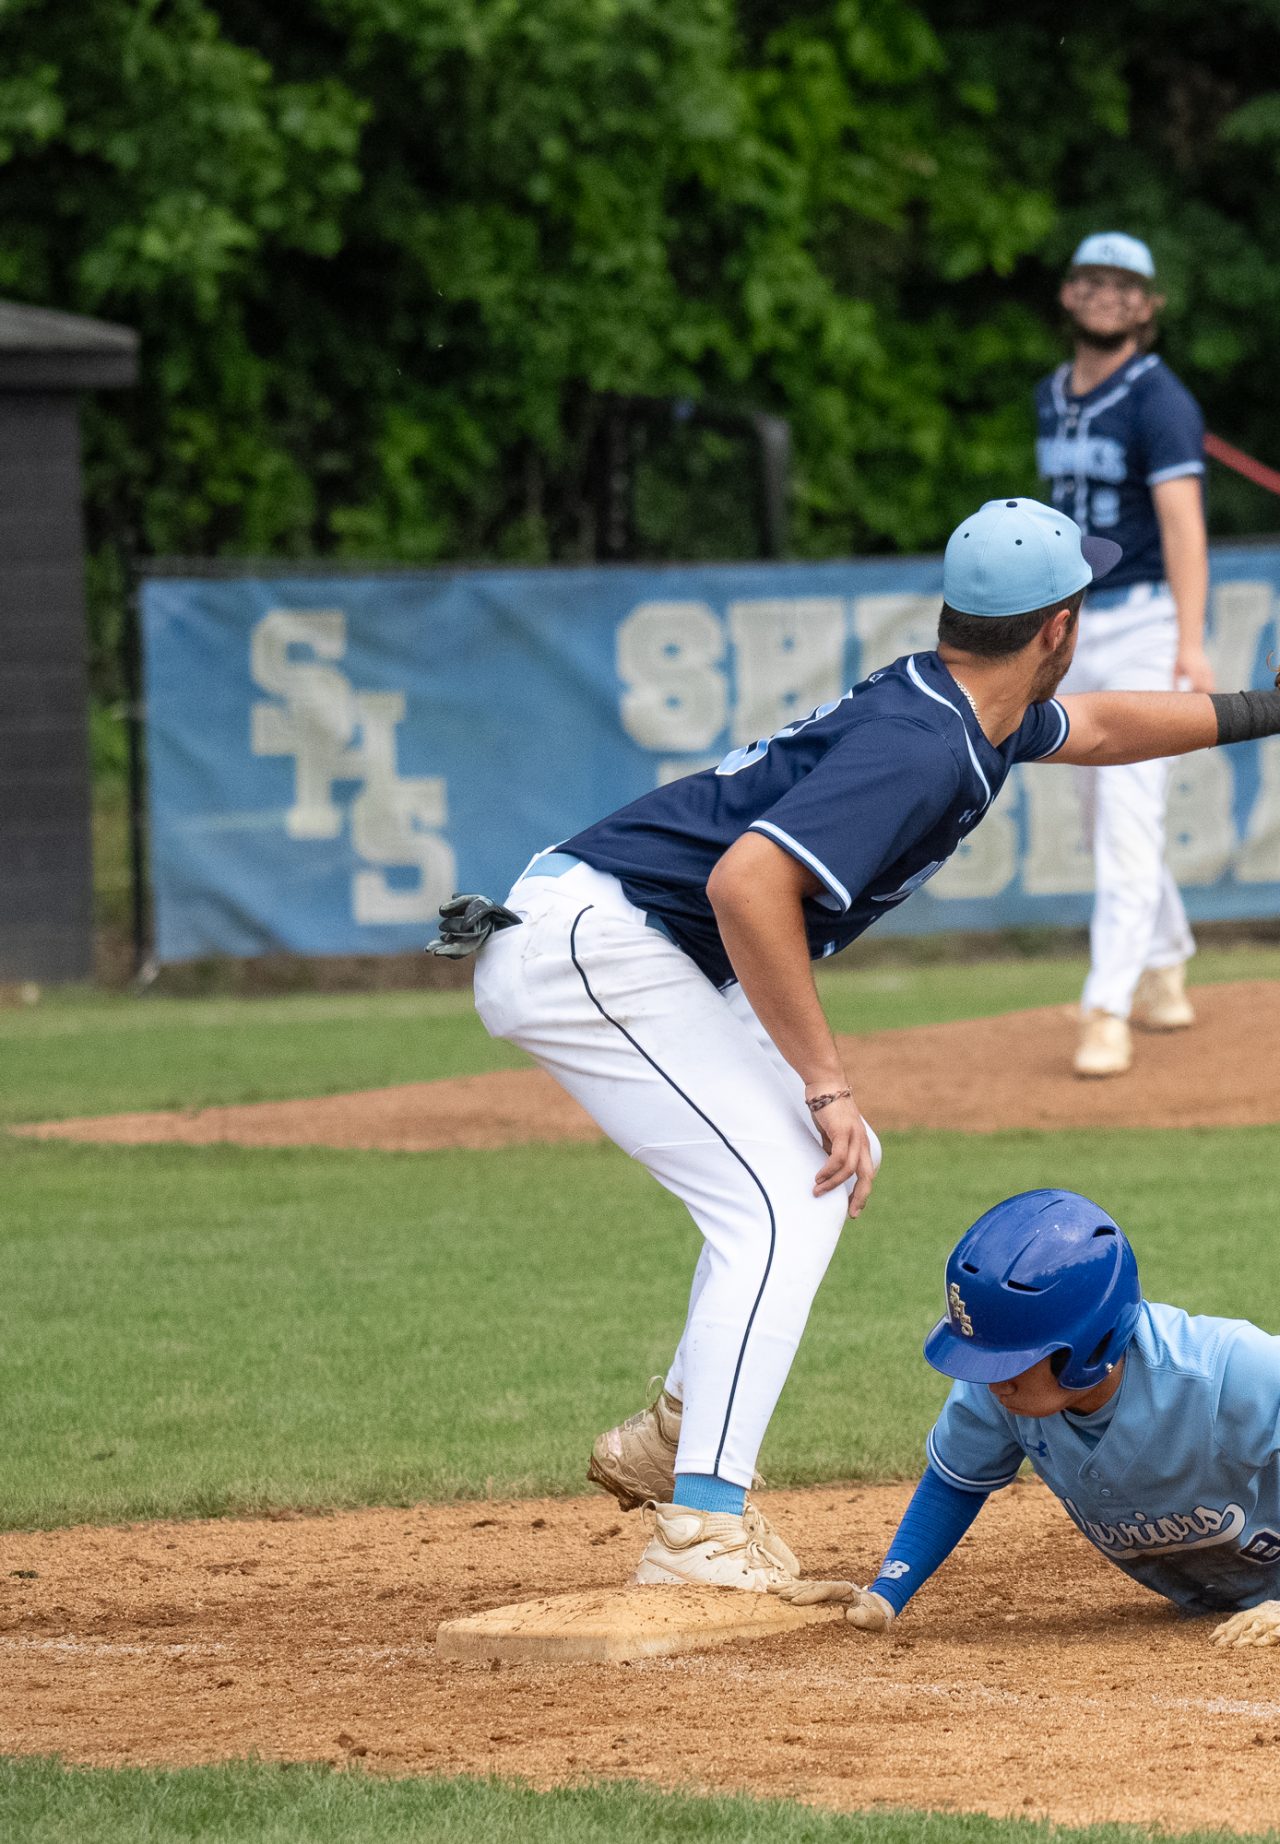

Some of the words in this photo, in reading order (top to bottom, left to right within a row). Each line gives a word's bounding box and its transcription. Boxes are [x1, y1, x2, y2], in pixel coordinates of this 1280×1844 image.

[250, 608, 458, 925] SHS
[950, 1282, 974, 1337] SHS
[1064, 1496, 1247, 1560] arriors
